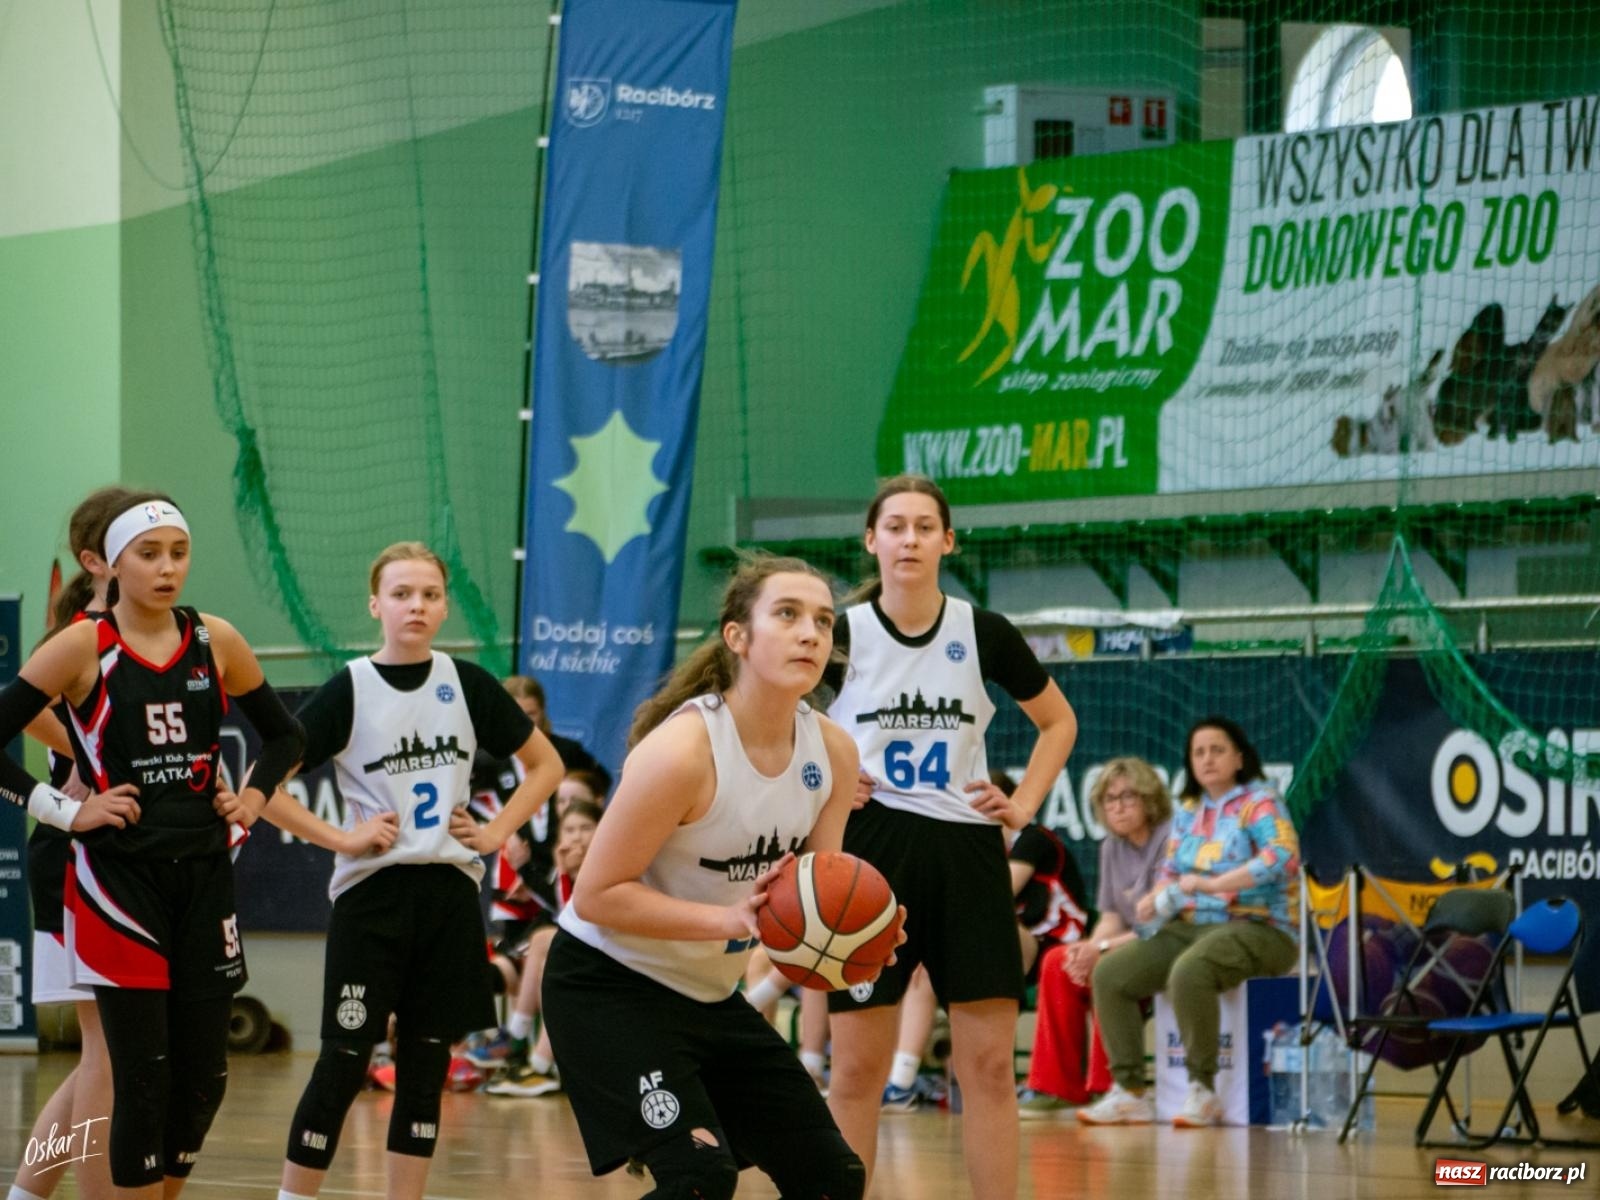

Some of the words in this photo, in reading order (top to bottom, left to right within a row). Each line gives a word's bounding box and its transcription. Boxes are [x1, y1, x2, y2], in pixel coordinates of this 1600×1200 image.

[616, 84, 715, 110] Racibórz
[1257, 117, 1444, 208] WSZYSTKO
[1456, 107, 1525, 186] DLA
[1045, 187, 1200, 280] ZOO
[1243, 200, 1465, 294] DOMOWEGO
[1473, 190, 1561, 270] ZOO
[1011, 279, 1182, 364] MAR
[998, 369, 1049, 394] sklep
[533, 615, 608, 650] Dodaj
[611, 623, 654, 645] coś
[530, 647, 557, 671] od
[145, 702, 188, 745] 55
[877, 713, 960, 730] WARSAW
[383, 750, 459, 775] WARSAW
[884, 740, 951, 790] 64
[412, 782, 440, 829] 2
[728, 862, 772, 882] WAR
[1508, 840, 1600, 880] RACIBÓ
[340, 984, 366, 1000] AW
[639, 1070, 663, 1094] AF
